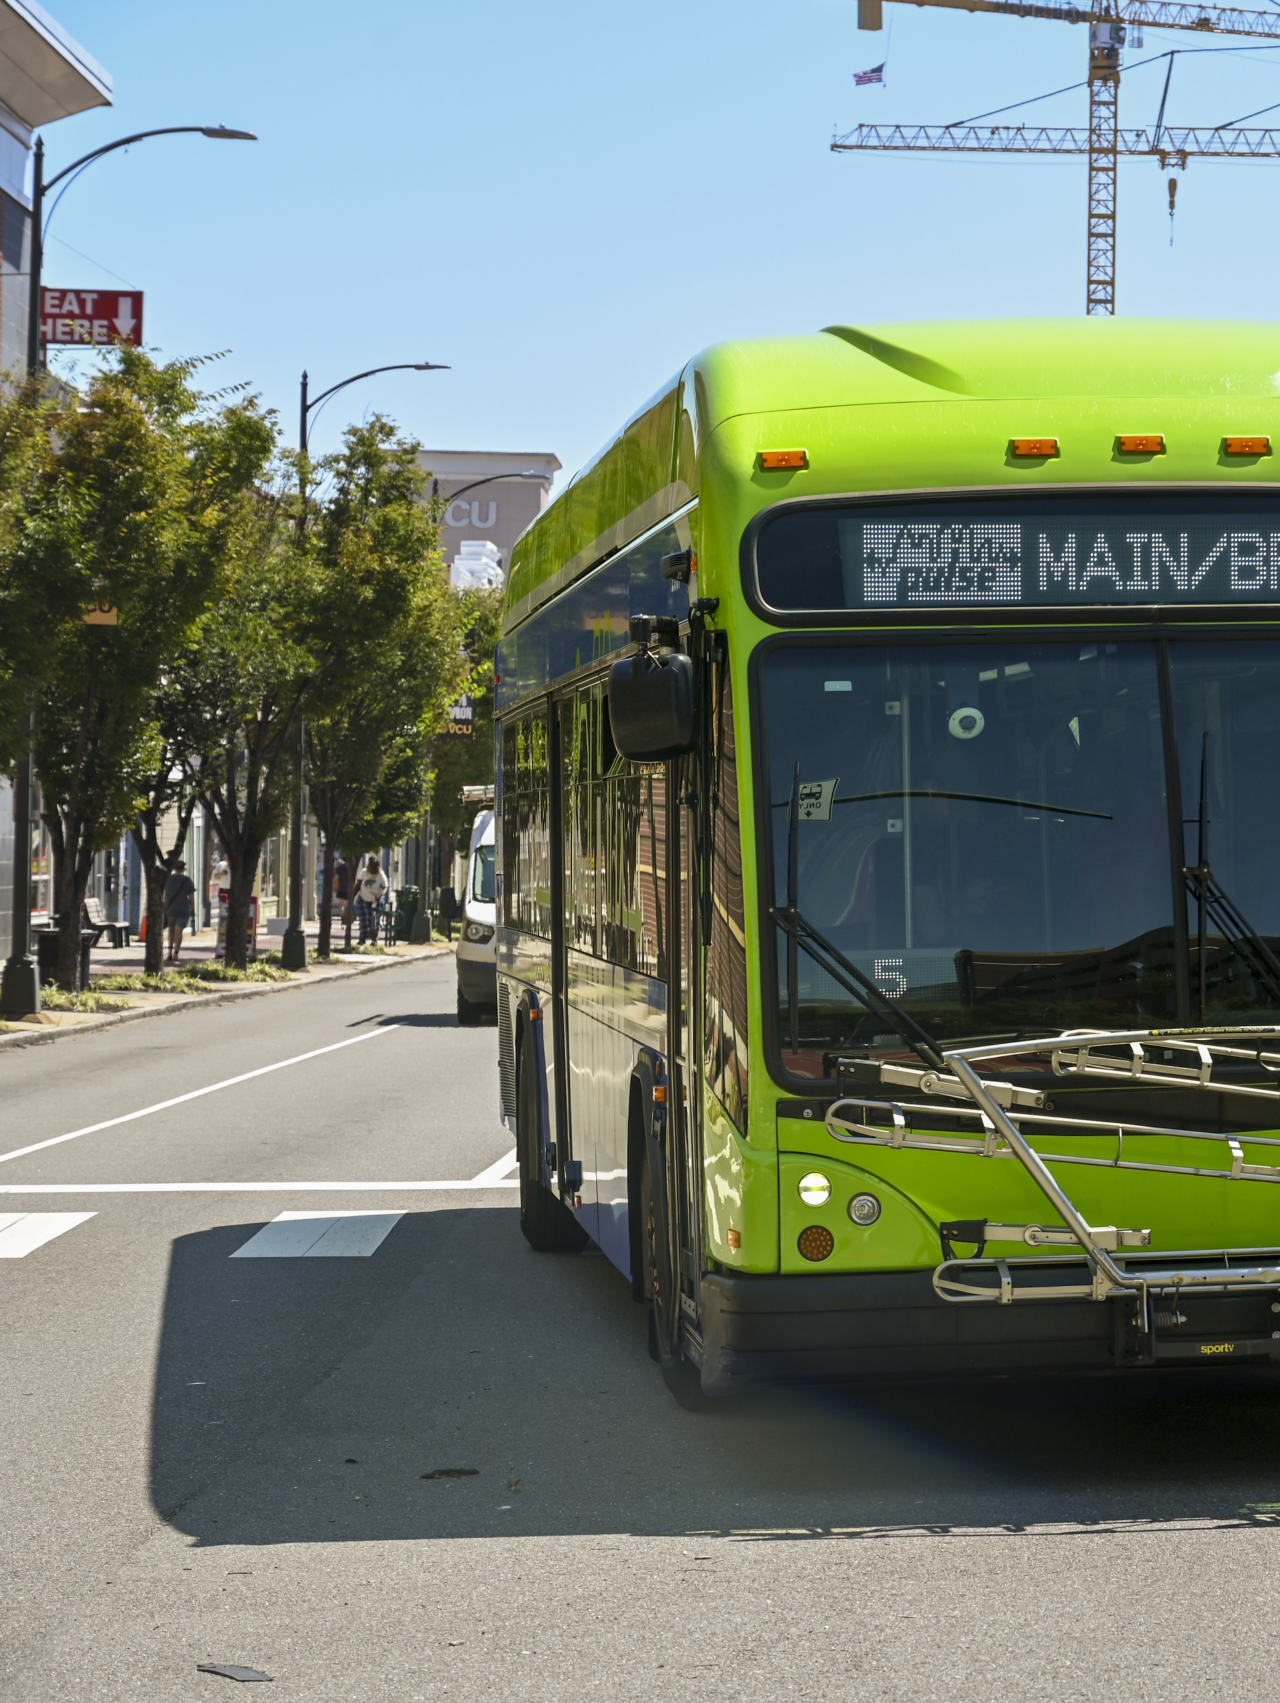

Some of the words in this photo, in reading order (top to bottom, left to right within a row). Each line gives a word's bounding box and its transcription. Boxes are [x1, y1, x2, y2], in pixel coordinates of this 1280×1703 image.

[43, 290, 98, 315] EAT
[39, 317, 109, 342] HERE
[874, 958, 907, 998] 5
